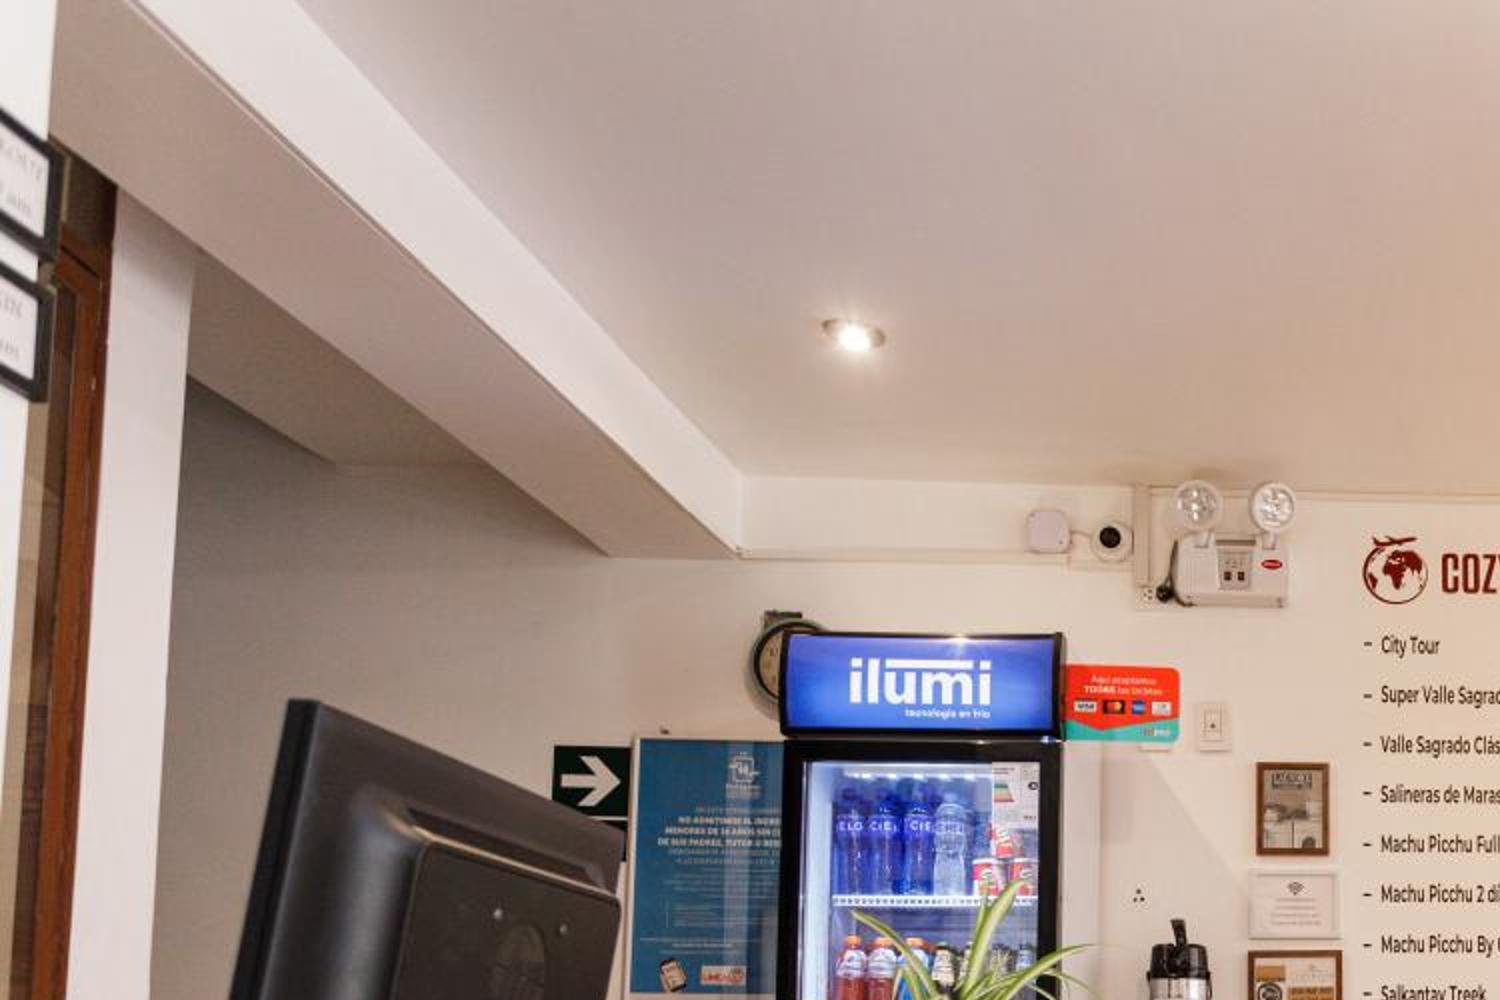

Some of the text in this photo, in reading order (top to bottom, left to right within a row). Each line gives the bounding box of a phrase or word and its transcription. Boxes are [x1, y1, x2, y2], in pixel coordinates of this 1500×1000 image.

[1381, 635, 1441, 659] City Tour
[850, 657, 993, 706] ilumi
[1381, 685, 1419, 708] Super
[1421, 685, 1455, 704] Valle
[1380, 735, 1413, 754] Valle
[1415, 735, 1471, 759] Sagrado
[1381, 784, 1441, 804] Salineras
[1443, 785, 1461, 804] de
[1381, 834, 1425, 853] Machu
[1428, 834, 1473, 854] Picchu
[1476, 835, 1500, 854] Full
[1381, 884, 1425, 904] Machu
[1428, 883, 1473, 904] Picchu
[1476, 884, 1485, 904] 2
[1381, 935, 1425, 954] Machu
[1428, 934, 1473, 954] Picchu
[1477, 935, 1495, 959] By
